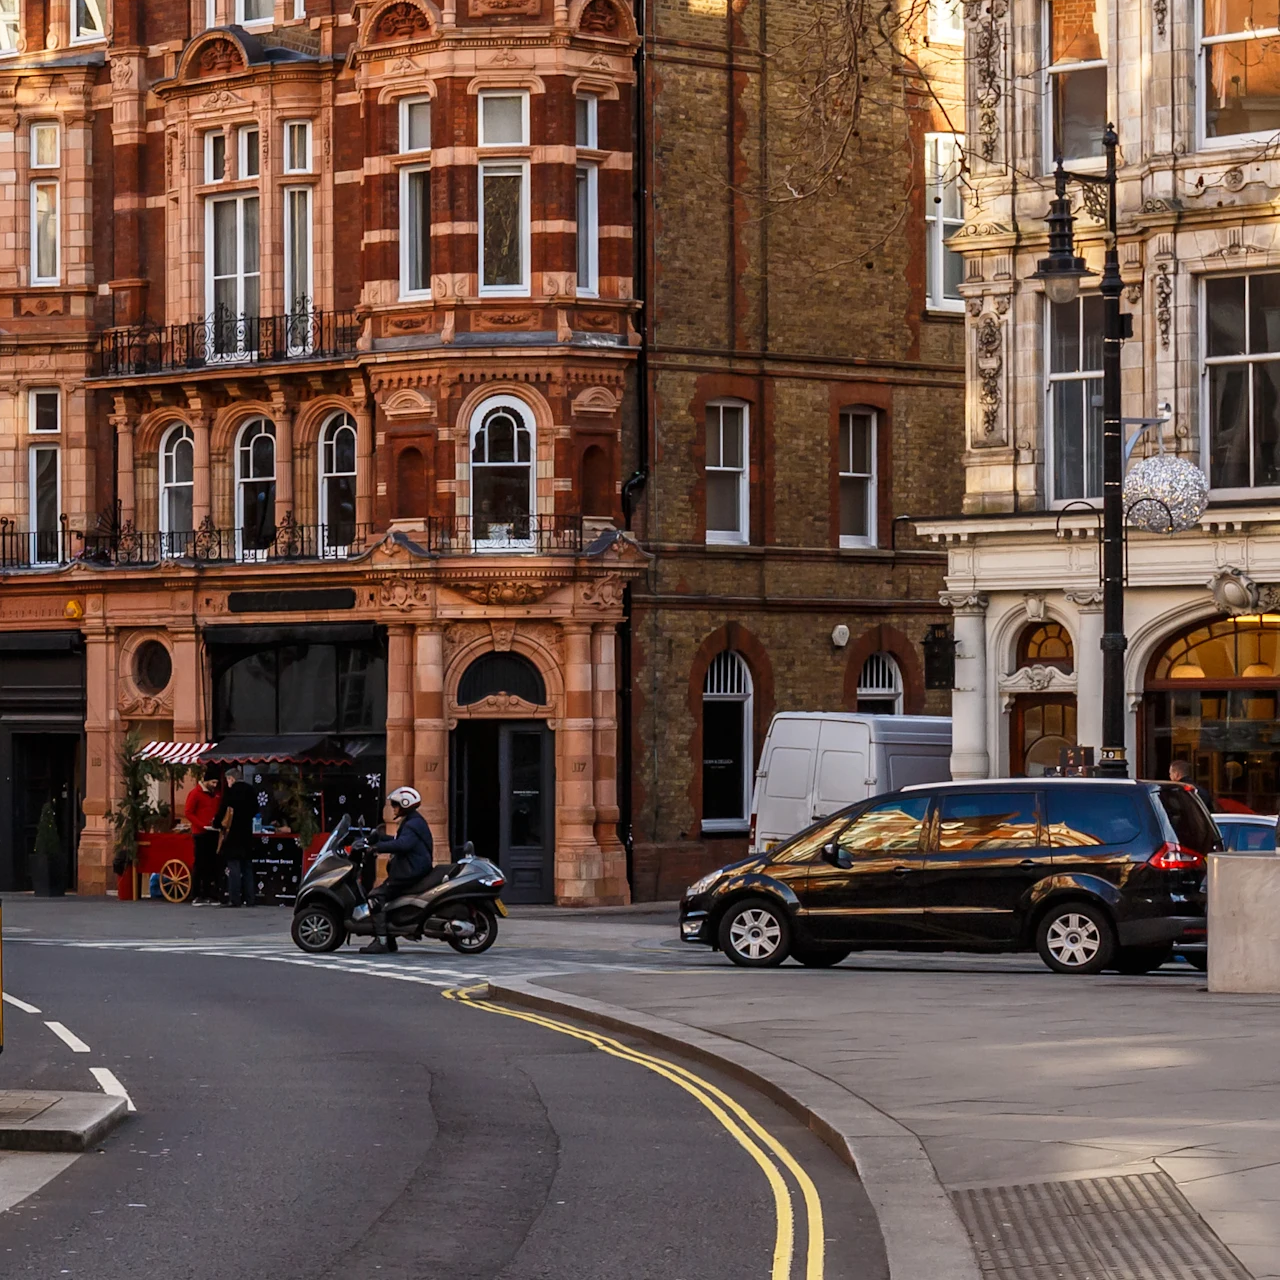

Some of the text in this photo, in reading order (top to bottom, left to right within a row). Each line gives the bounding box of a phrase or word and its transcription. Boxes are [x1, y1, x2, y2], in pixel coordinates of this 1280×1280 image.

[1102, 751, 1115, 759] 20
[424, 762, 439, 772] 117
[572, 762, 587, 772] 117
